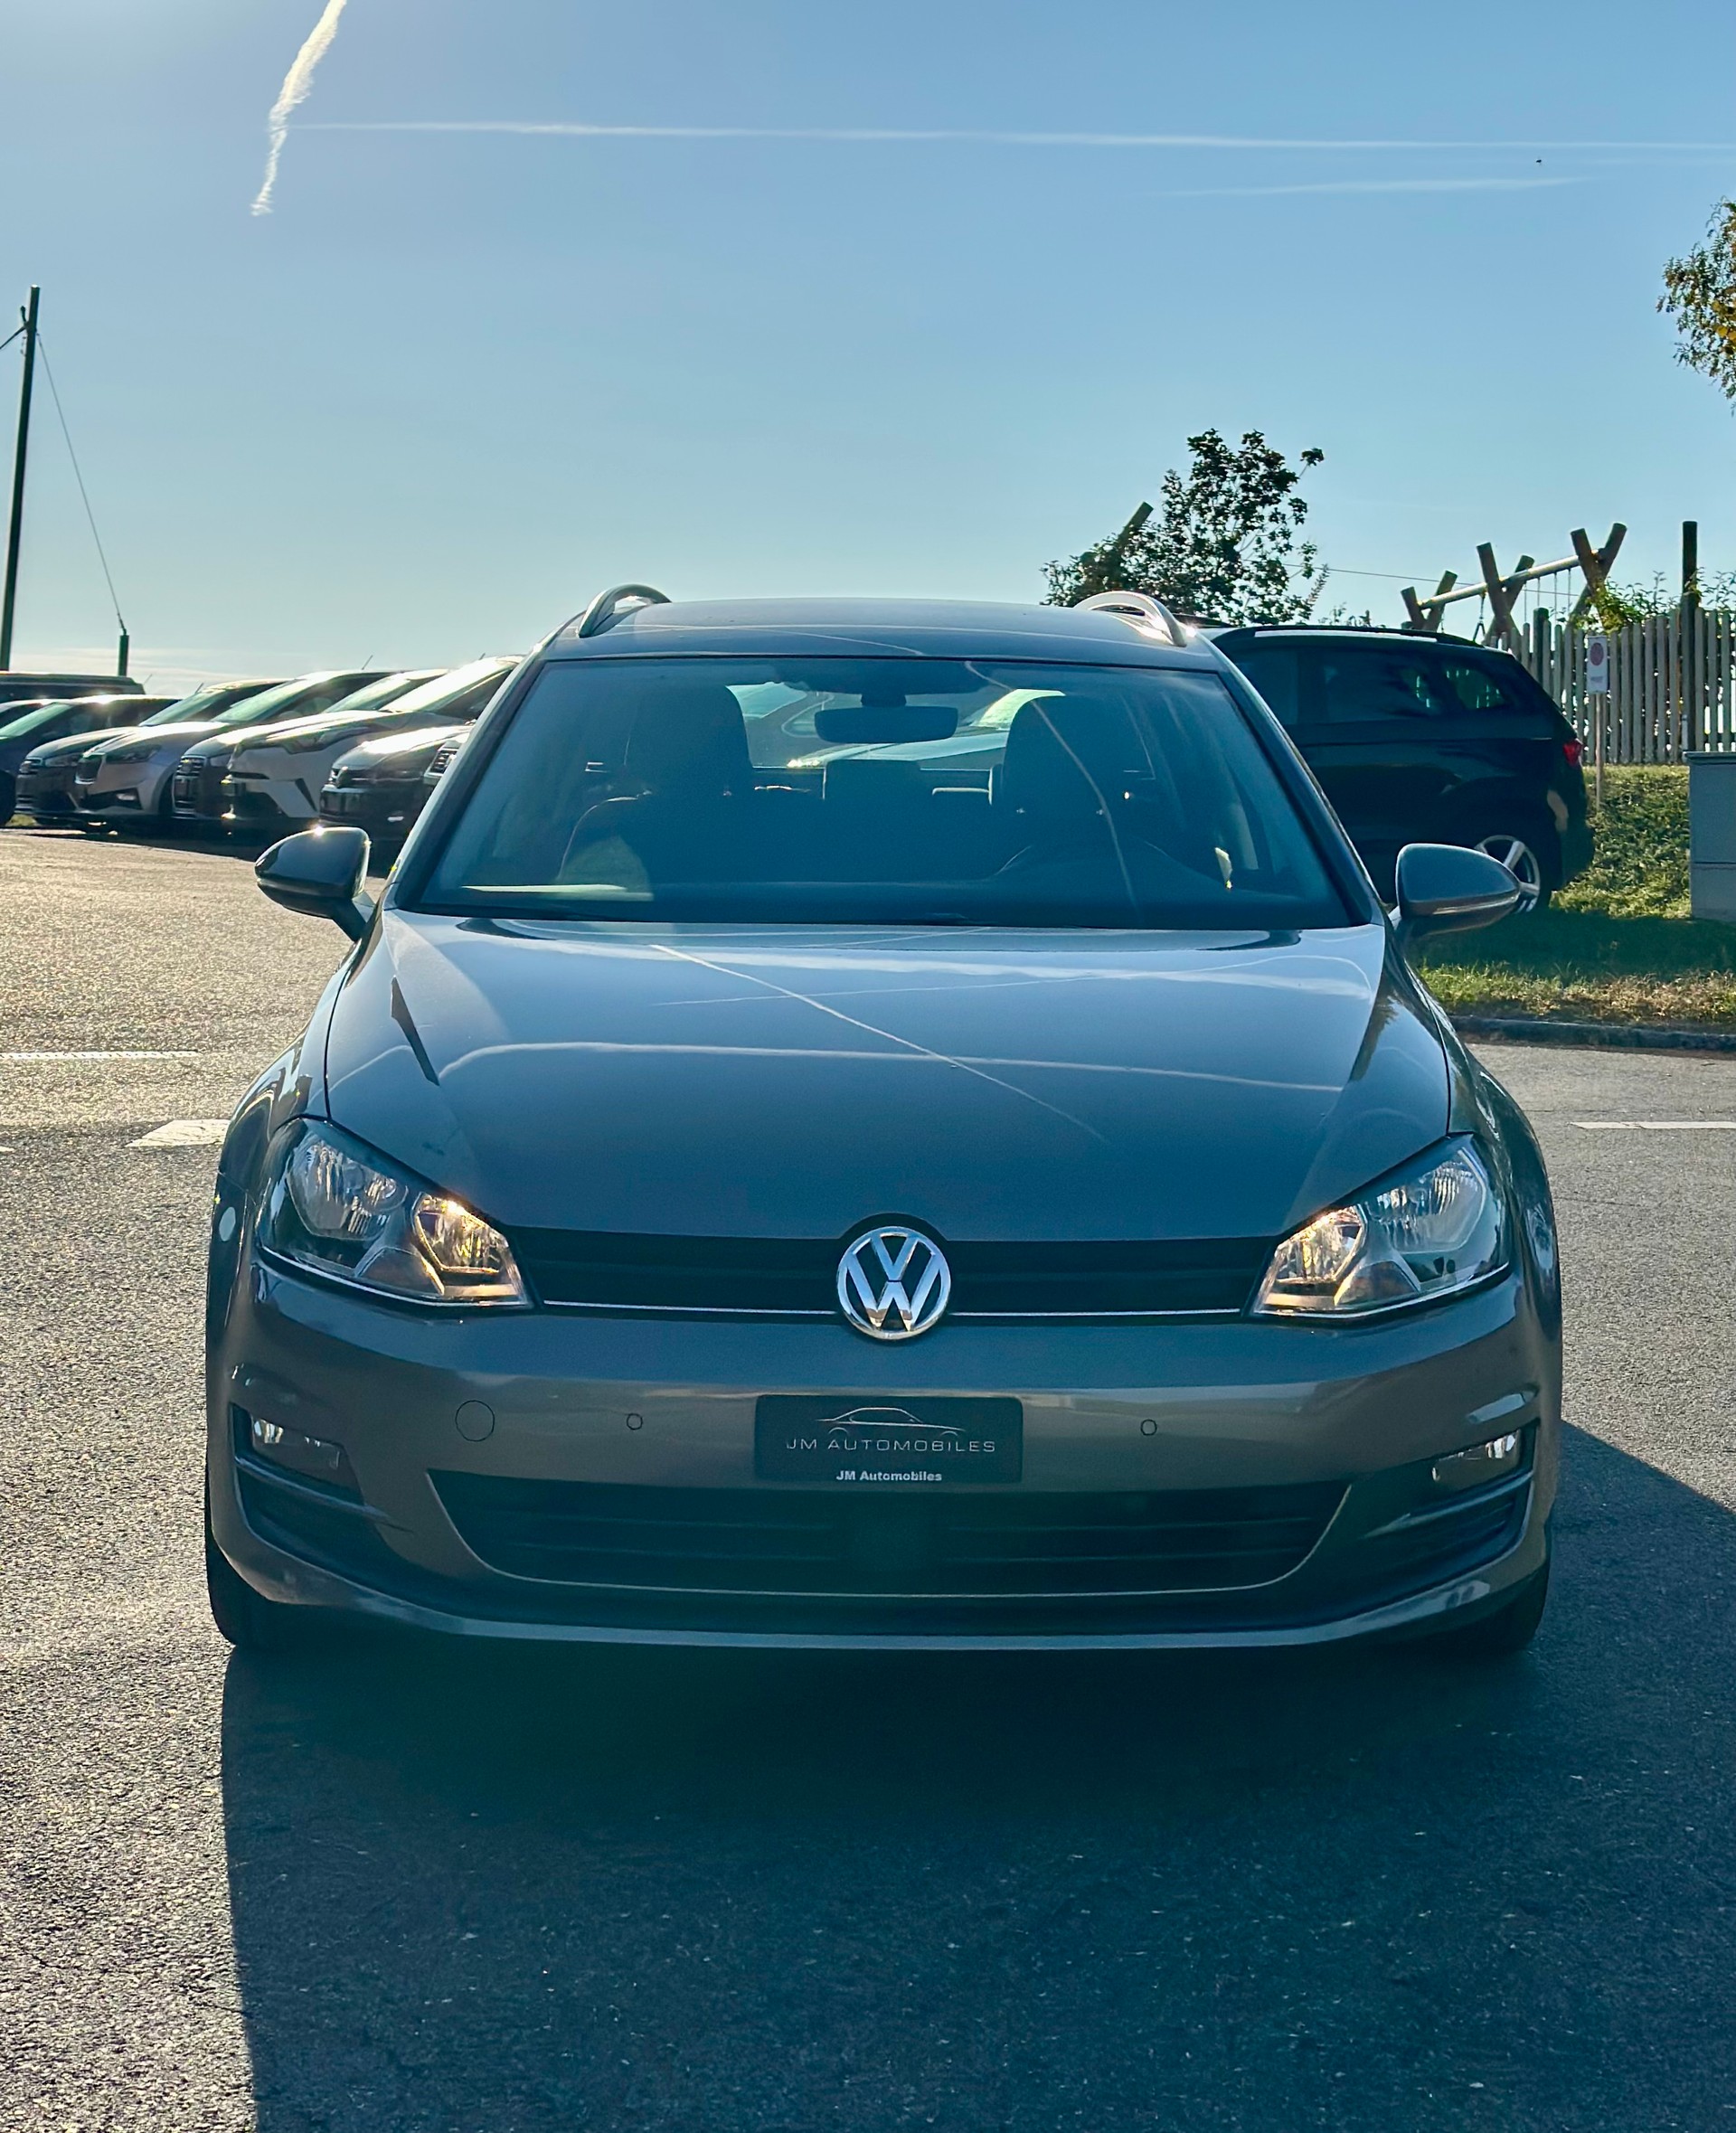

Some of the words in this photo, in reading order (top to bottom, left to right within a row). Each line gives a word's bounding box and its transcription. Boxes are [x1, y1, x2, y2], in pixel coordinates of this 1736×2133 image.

[786, 1439, 817, 1450] JM
[827, 1439, 996, 1453] AUTOMOBILES
[835, 1470, 856, 1482] JM
[859, 1470, 943, 1483] Automobiles
